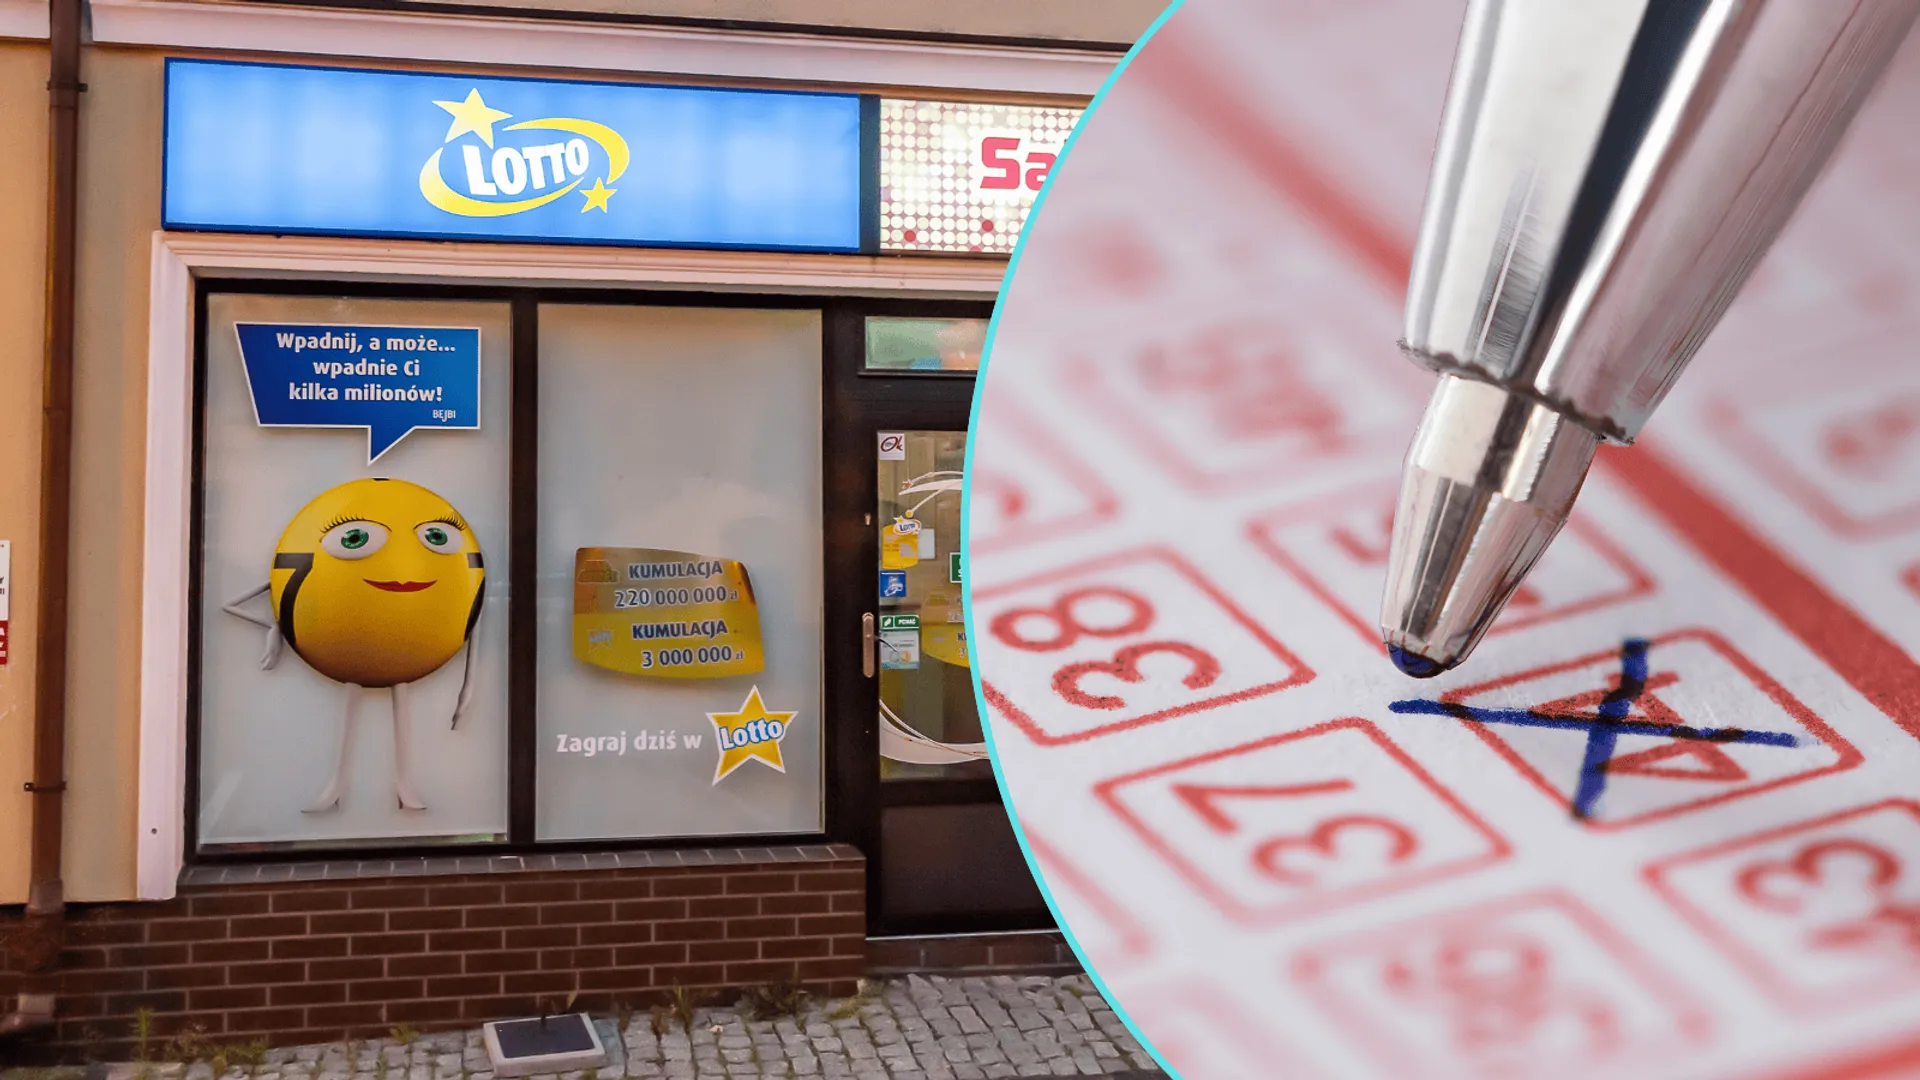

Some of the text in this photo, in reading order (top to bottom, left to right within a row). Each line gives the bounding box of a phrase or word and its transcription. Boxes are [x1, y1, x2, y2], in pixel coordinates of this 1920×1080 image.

[462, 138, 590, 196] LOTTO
[276, 332, 456, 353] Wpadnij, a może...
[313, 358, 420, 379] wpadnie Ci
[289, 383, 443, 402] kilka milionów!
[432, 409, 456, 422] BEJBI
[629, 561, 723, 580] KUMULACJA
[273, 552, 315, 646] 7
[614, 589, 650, 608] 220
[655, 588, 688, 605] 000
[693, 586, 726, 602] 000
[632, 620, 728, 640] KUMULACJA
[641, 651, 653, 669] 3
[659, 649, 693, 666] 000
[697, 646, 732, 663] 000
[989, 586, 1222, 711] 38
[556, 718, 785, 757] Zagraj dziś w Lotto
[1168, 777, 1421, 887] 37
